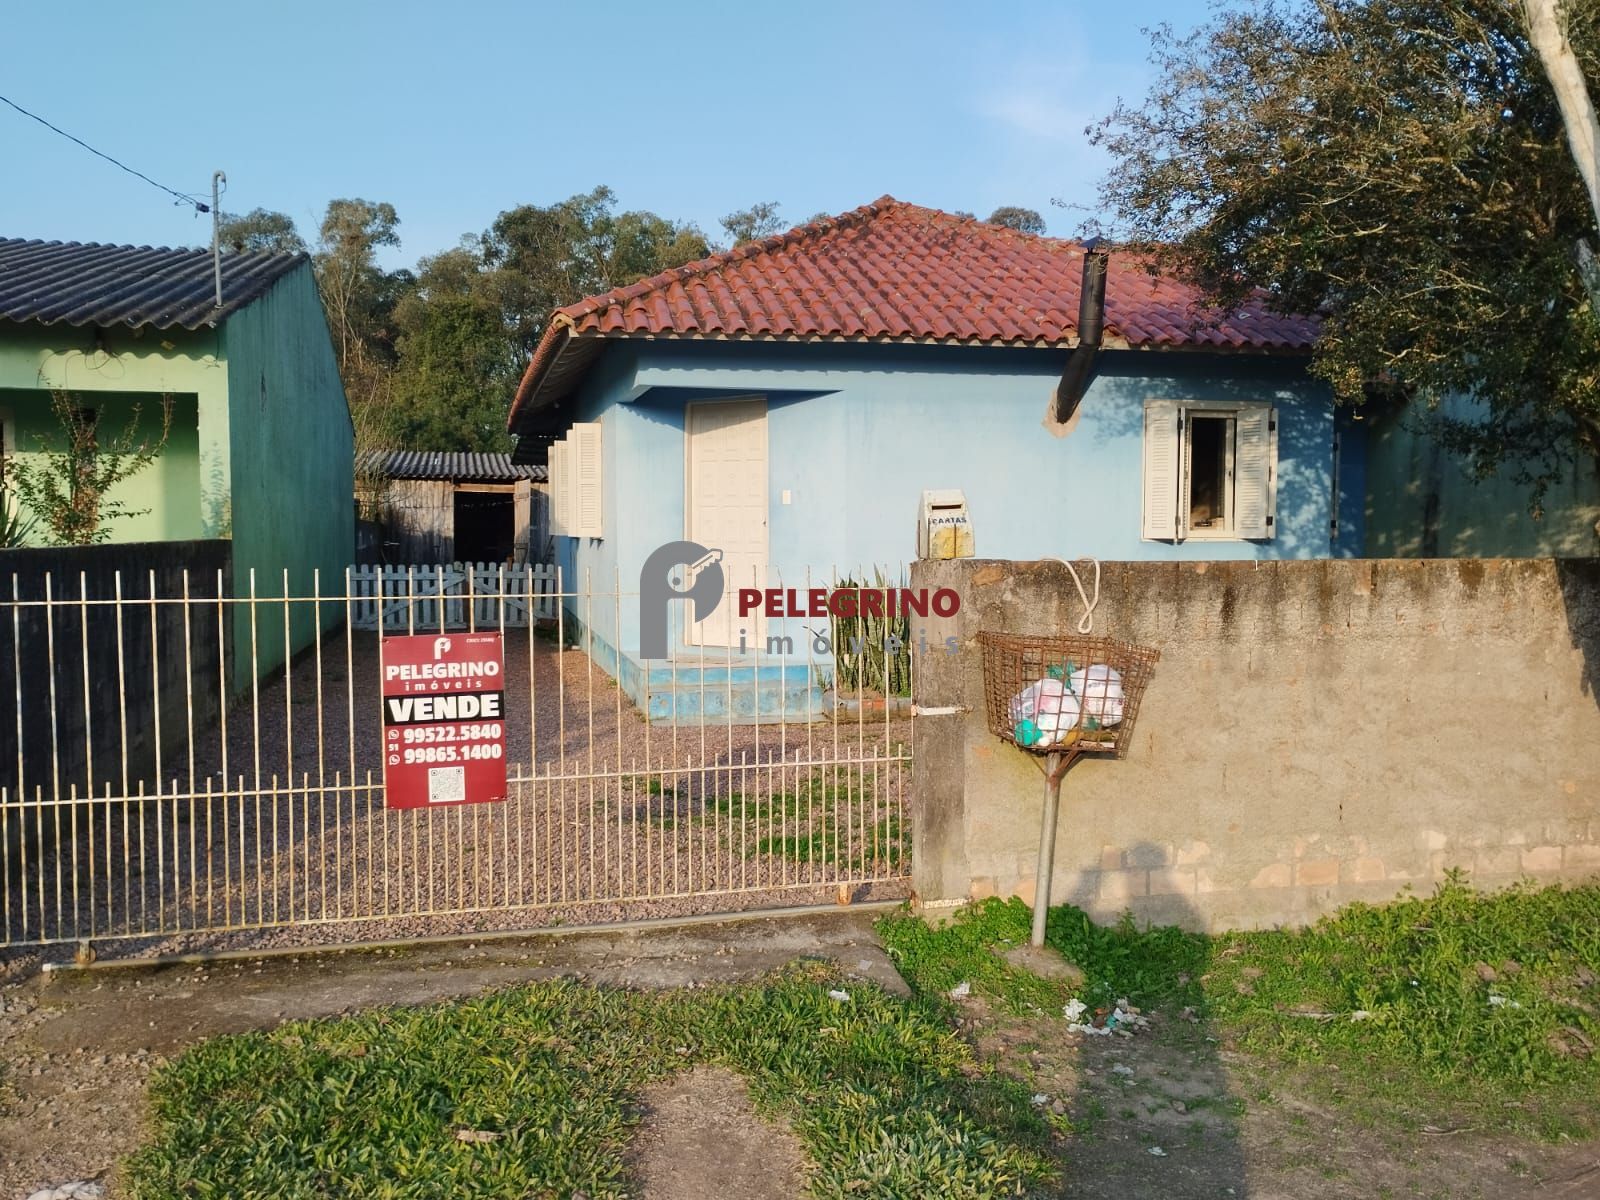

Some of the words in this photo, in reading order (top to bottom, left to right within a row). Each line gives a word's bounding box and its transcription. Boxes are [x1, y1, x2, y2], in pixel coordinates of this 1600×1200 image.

[931, 516, 967, 525] CARTAS
[386, 661, 499, 680] PELEGRINO
[405, 679, 482, 691] imóveis
[388, 694, 500, 722] VENDE
[403, 724, 501, 744] 99522.5840
[404, 743, 502, 764] 99865.1400
